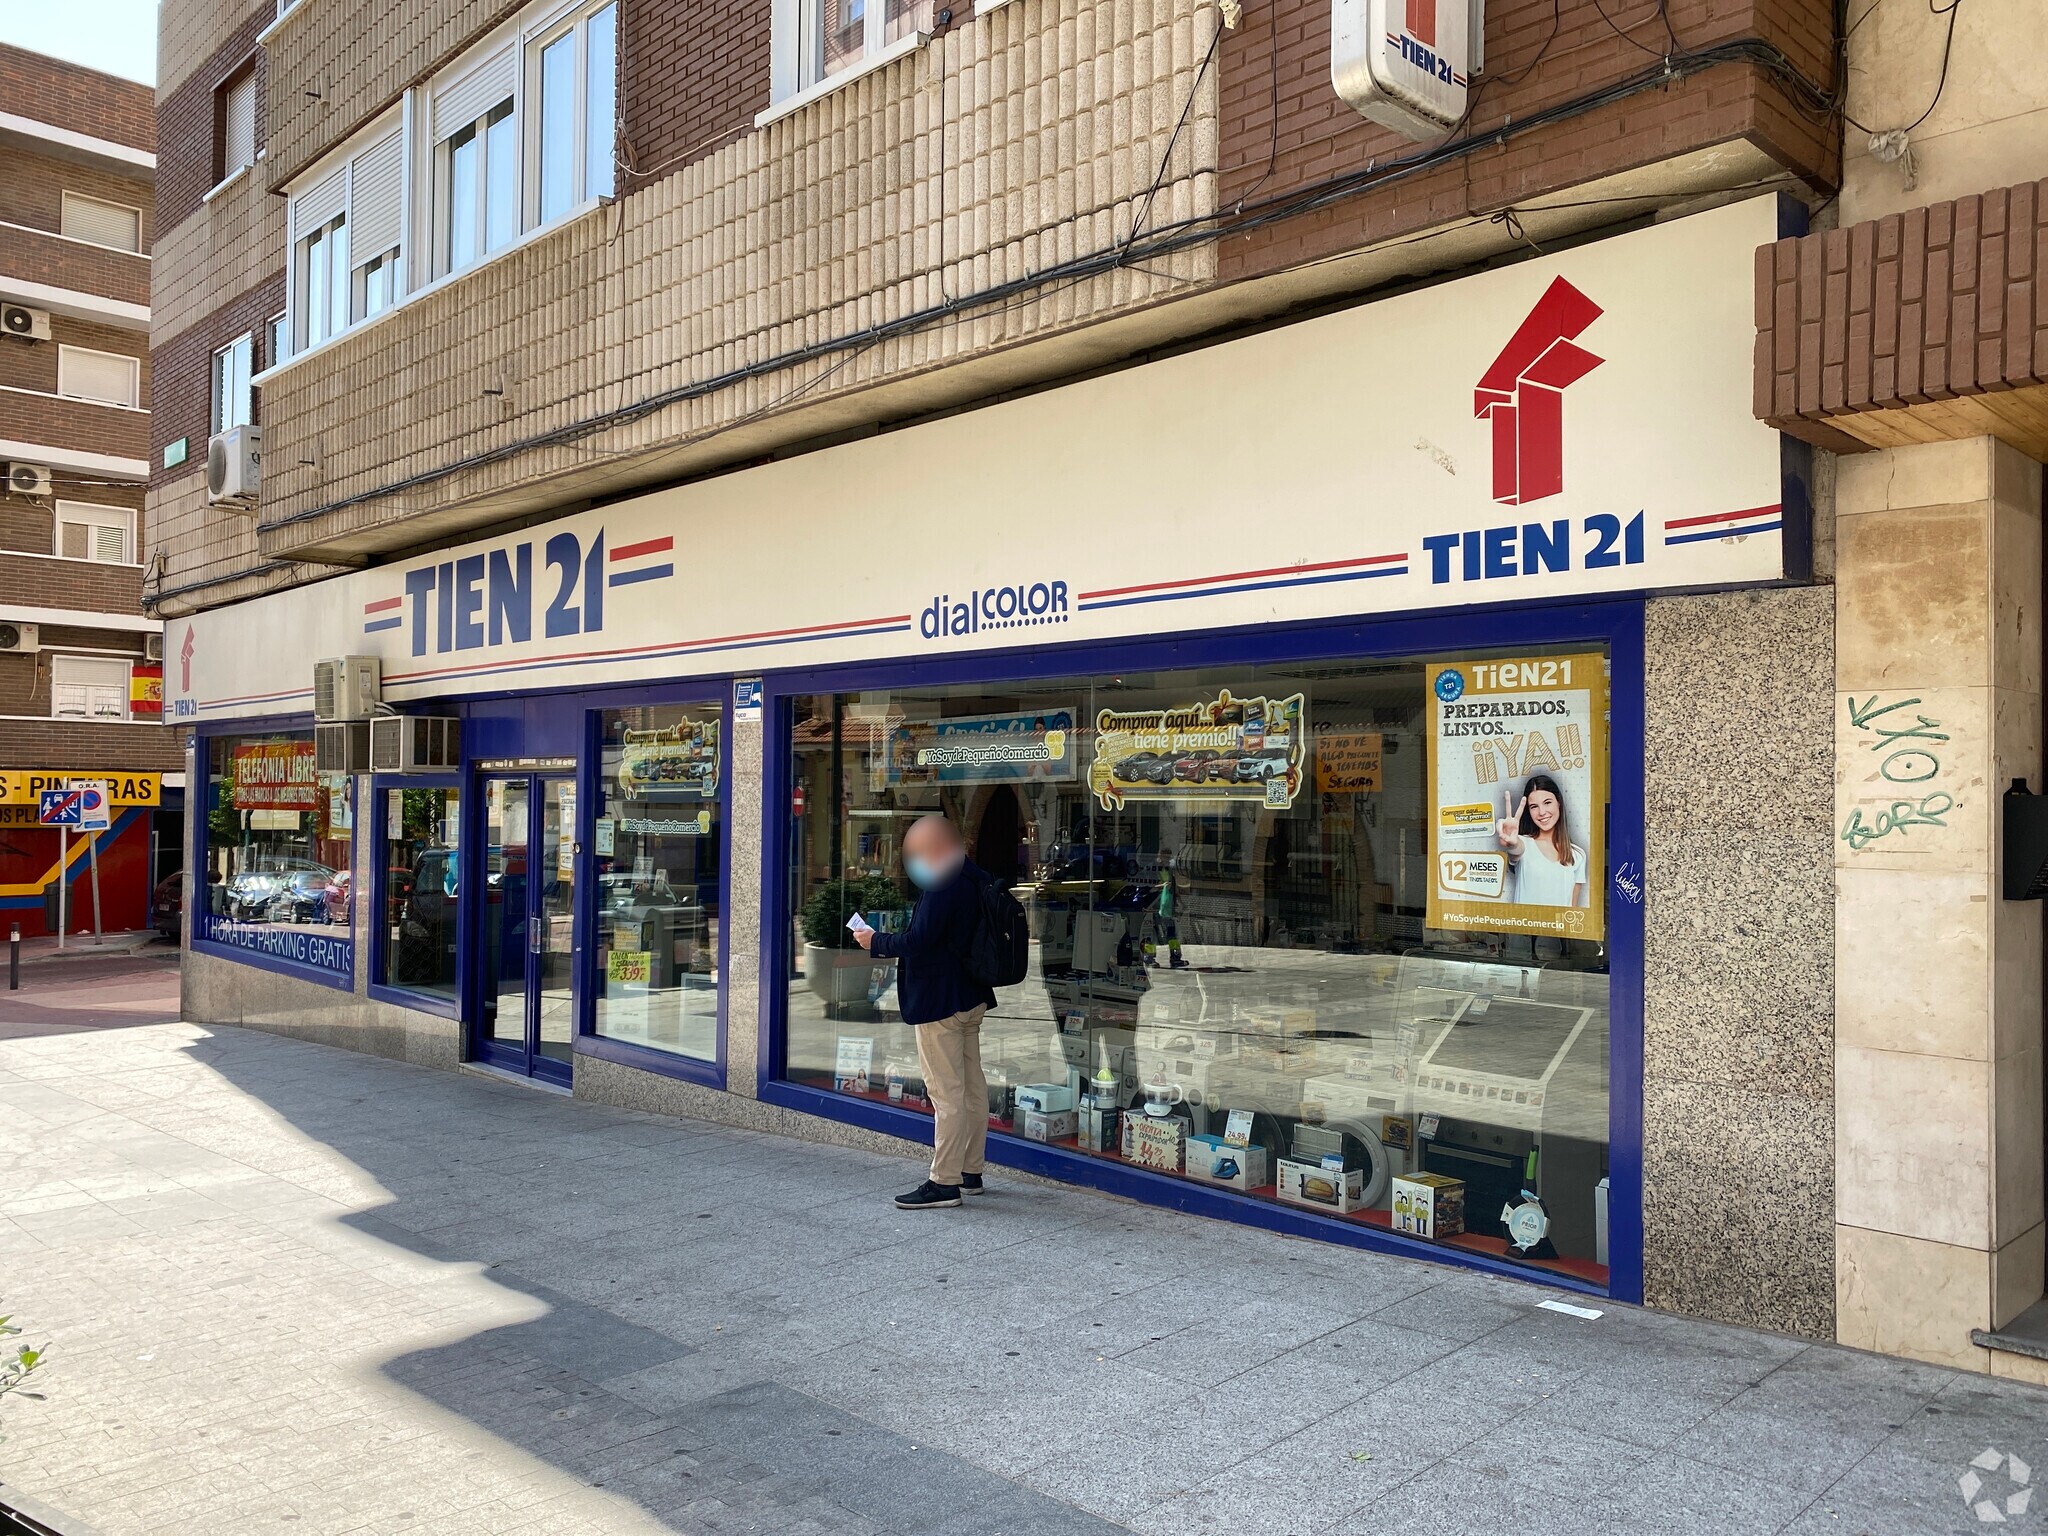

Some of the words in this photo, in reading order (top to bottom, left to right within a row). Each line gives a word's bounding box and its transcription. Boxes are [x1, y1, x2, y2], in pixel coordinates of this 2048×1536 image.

[1399, 33, 1437, 76] TIEN
[1438, 57, 1452, 86] 21
[1422, 518, 1570, 584] TIEN
[1584, 508, 1645, 570] 21
[405, 541, 533, 657] TIEN
[545, 525, 604, 639] 21
[1444, 682, 1455, 690] T21
[174, 699, 190, 717] TIEN
[190, 698, 197, 716] 21
[1443, 700, 1571, 719] PREPARADOS,
[1100, 713, 1163, 736] Comprar
[1164, 706, 1214, 734] aquí...
[1443, 721, 1514, 737] LISTOS...
[625, 730, 655, 747] Comprar
[1133, 731, 1168, 749] tiene
[1173, 728, 1237, 754] premio!!
[287, 755, 315, 783] LIBRE
[1444, 860, 1468, 881] 12
[1469, 862, 1498, 872] MESES
[1443, 913, 1565, 930] #YoSoydePequeñoComercio
[204, 916, 209, 937] 1
[211, 917, 239, 945] HORA
[240, 923, 254, 949] DE
[257, 927, 305, 960] PARKING
[308, 937, 350, 972] GRATIS
